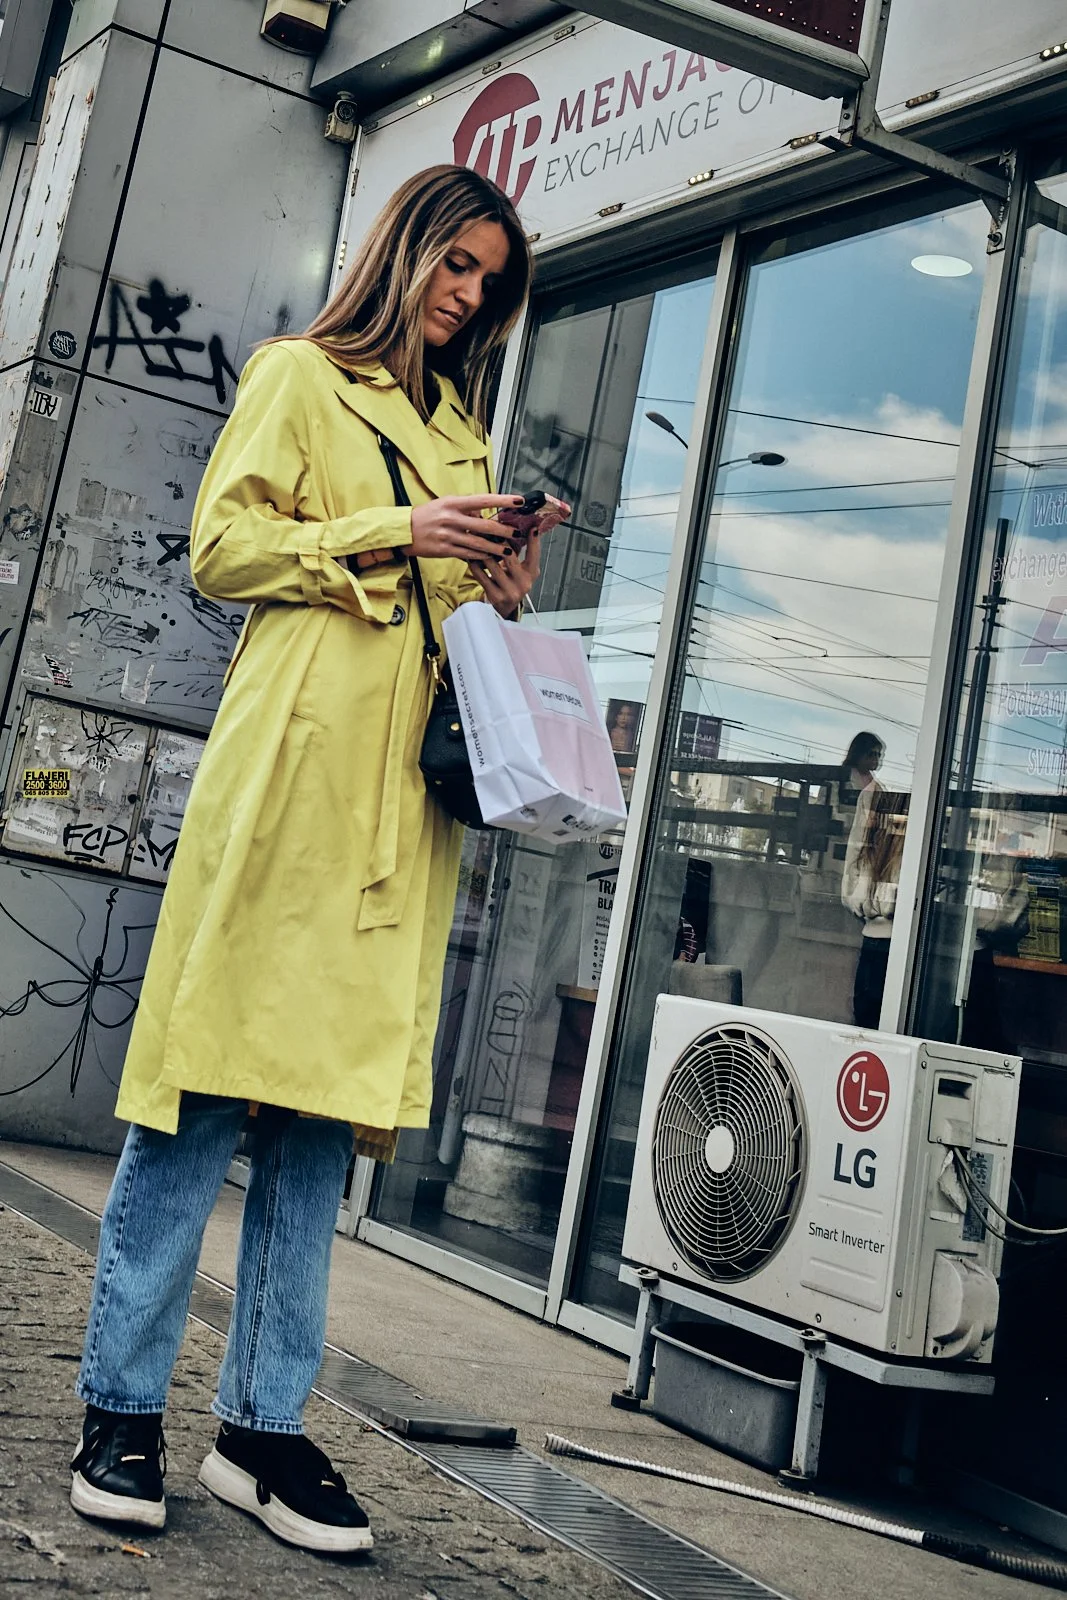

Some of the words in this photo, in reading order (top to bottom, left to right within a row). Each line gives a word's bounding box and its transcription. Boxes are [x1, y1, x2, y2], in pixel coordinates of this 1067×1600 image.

[544, 90, 723, 192] EXCHANGE
[456, 662, 486, 768] womensecret.com
[25, 770, 69, 780] FLAJERI
[63, 823, 128, 856] FCP
[833, 1142, 877, 1189] LG
[808, 1221, 839, 1242] Smart
[841, 1230, 886, 1254] Inverter
